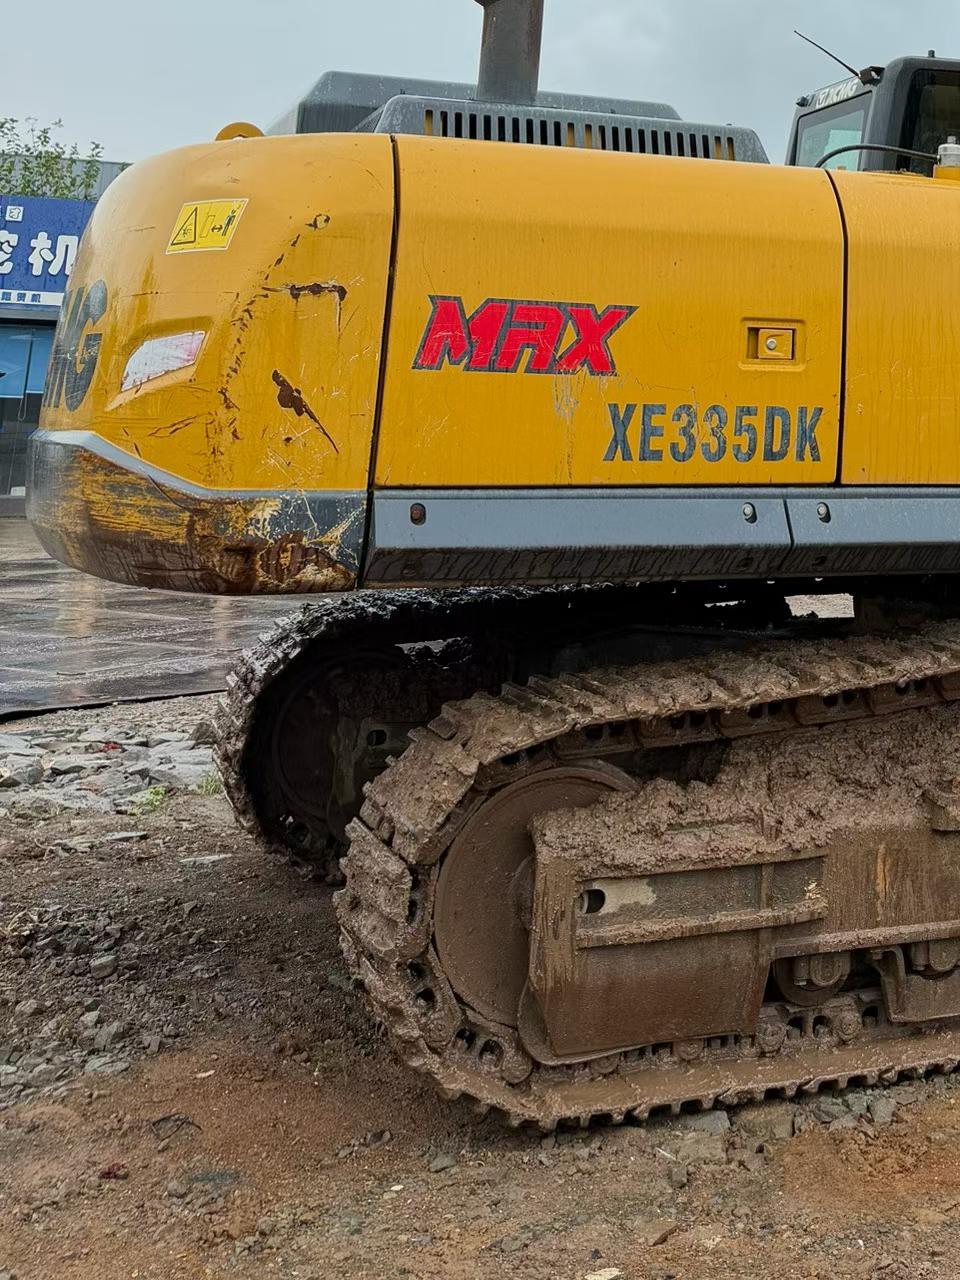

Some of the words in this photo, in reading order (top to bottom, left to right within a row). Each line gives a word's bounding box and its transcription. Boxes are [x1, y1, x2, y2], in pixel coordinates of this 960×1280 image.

[825, 78, 858, 106] XCMG
[411, 294, 640, 376] MAX
[602, 403, 824, 463] XE335DK
